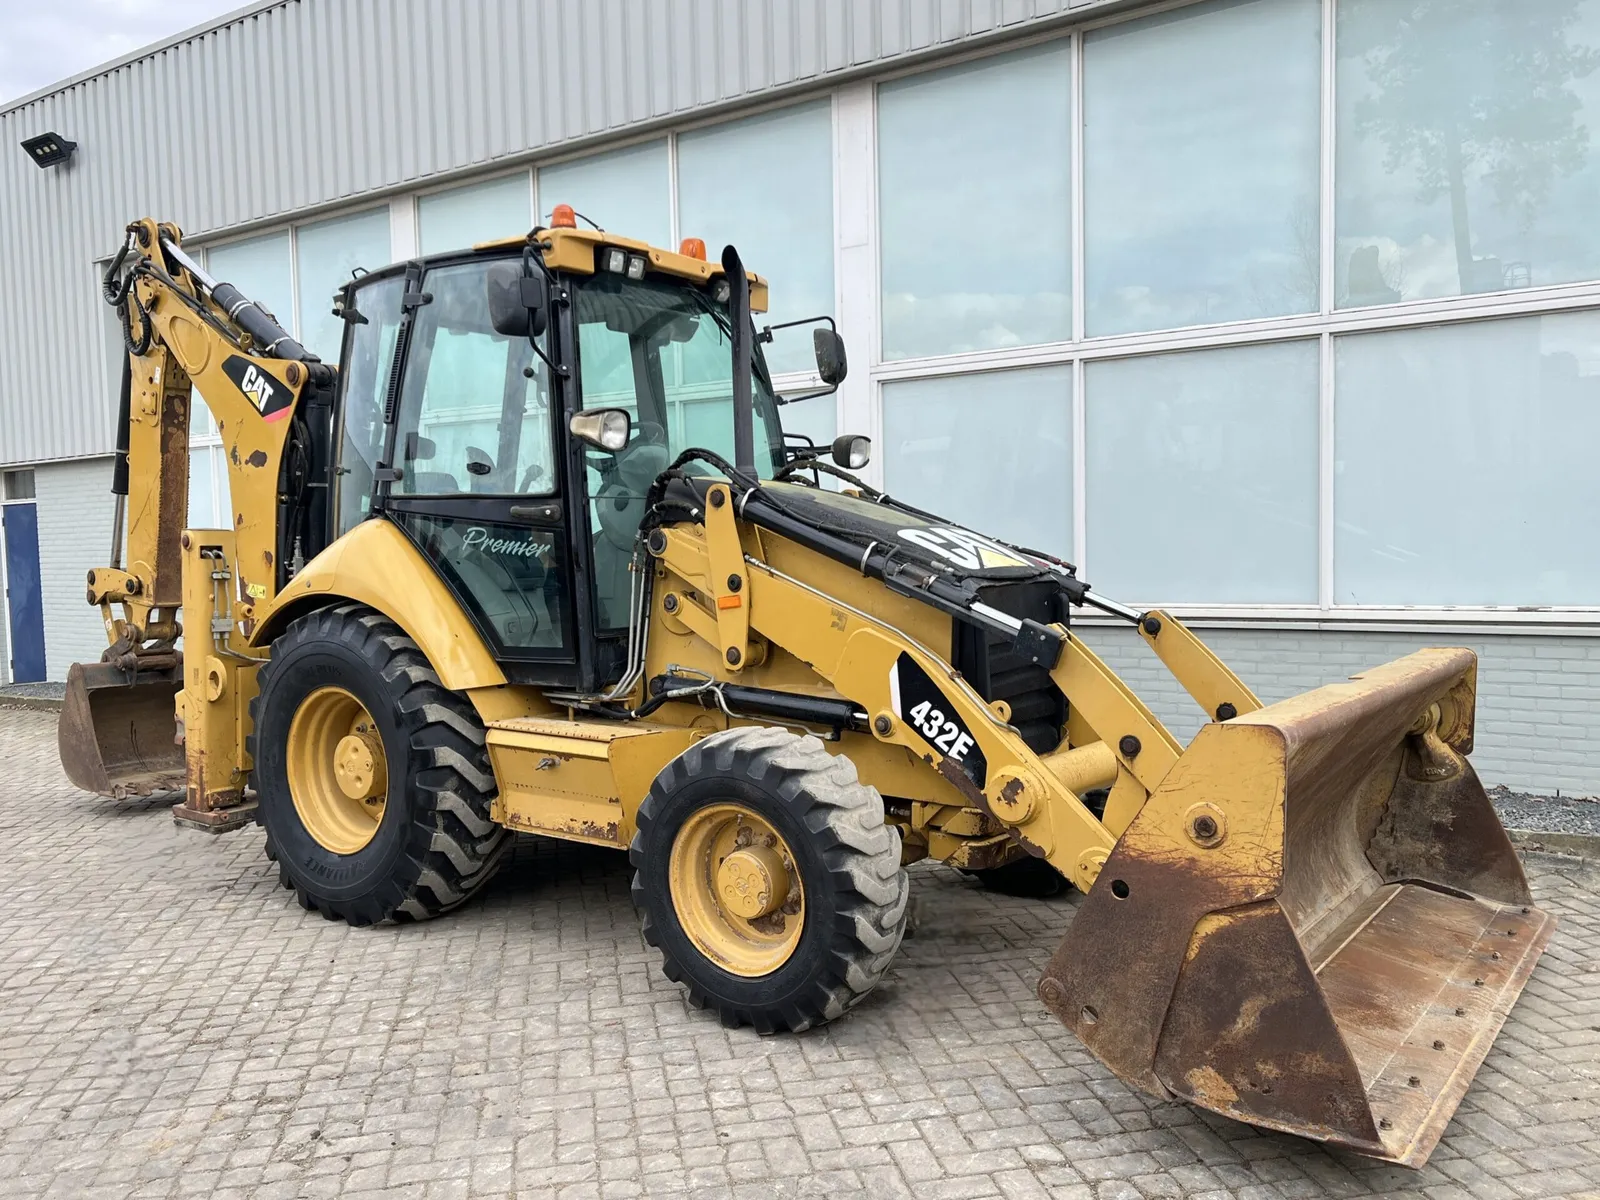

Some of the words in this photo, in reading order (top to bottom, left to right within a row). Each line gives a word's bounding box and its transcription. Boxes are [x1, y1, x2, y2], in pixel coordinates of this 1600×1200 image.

[241, 364, 274, 412] CAT
[462, 526, 551, 558] Premier
[909, 700, 975, 762] 432E
